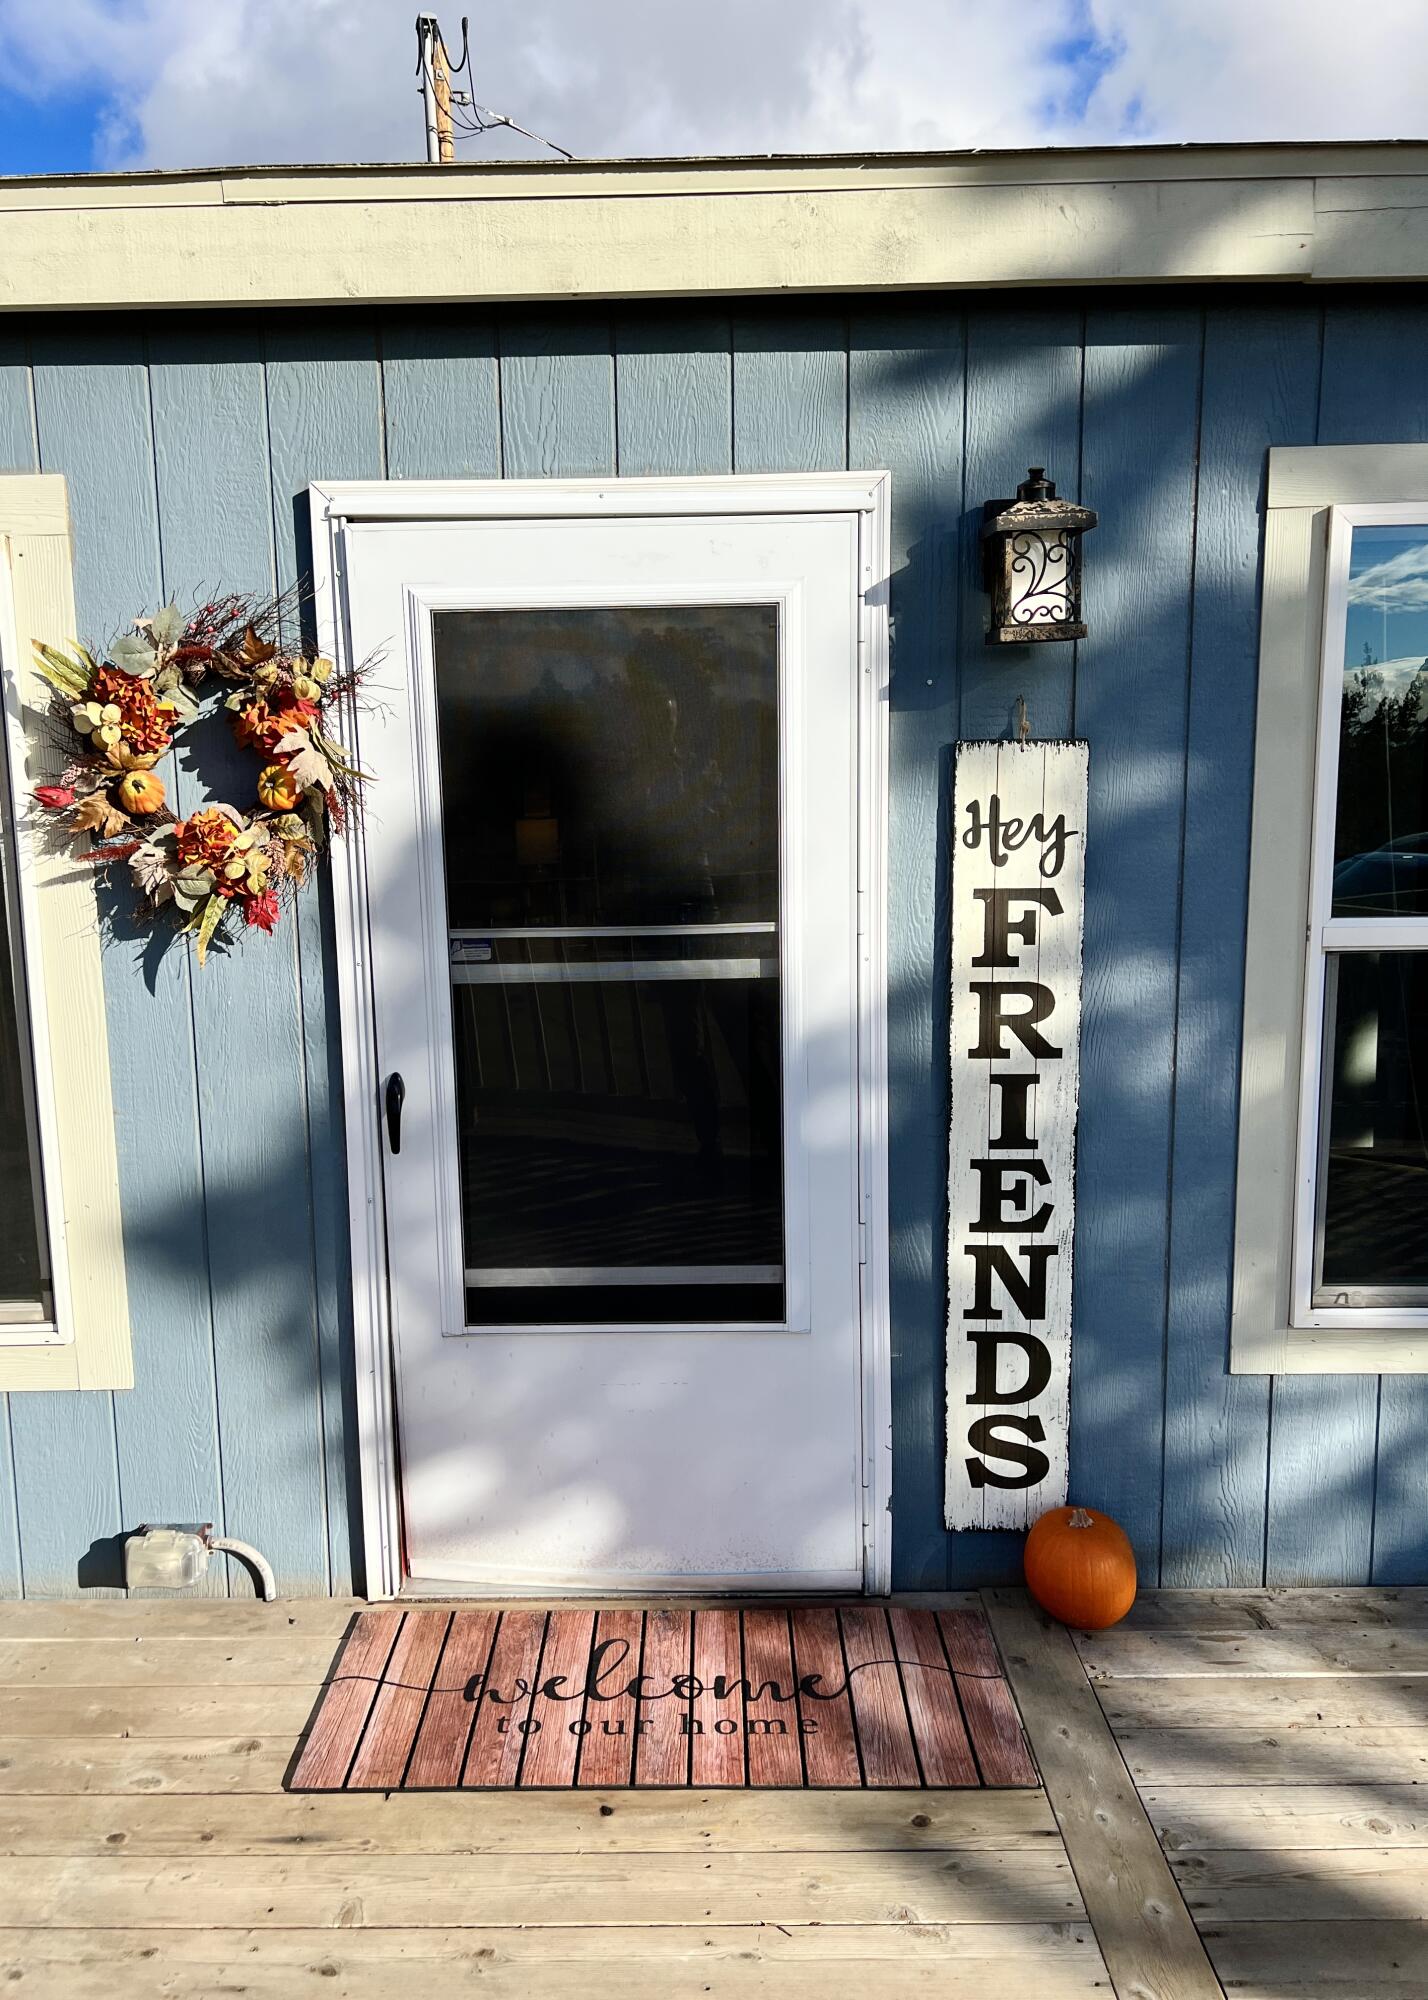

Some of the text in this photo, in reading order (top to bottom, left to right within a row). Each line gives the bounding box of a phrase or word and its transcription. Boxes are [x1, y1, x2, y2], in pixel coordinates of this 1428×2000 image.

[962, 793, 1079, 879] Hey
[964, 887, 1065, 1490] FRIENDS
[463, 1638, 848, 1704] welcome
[496, 1713, 819, 1736] to our home
